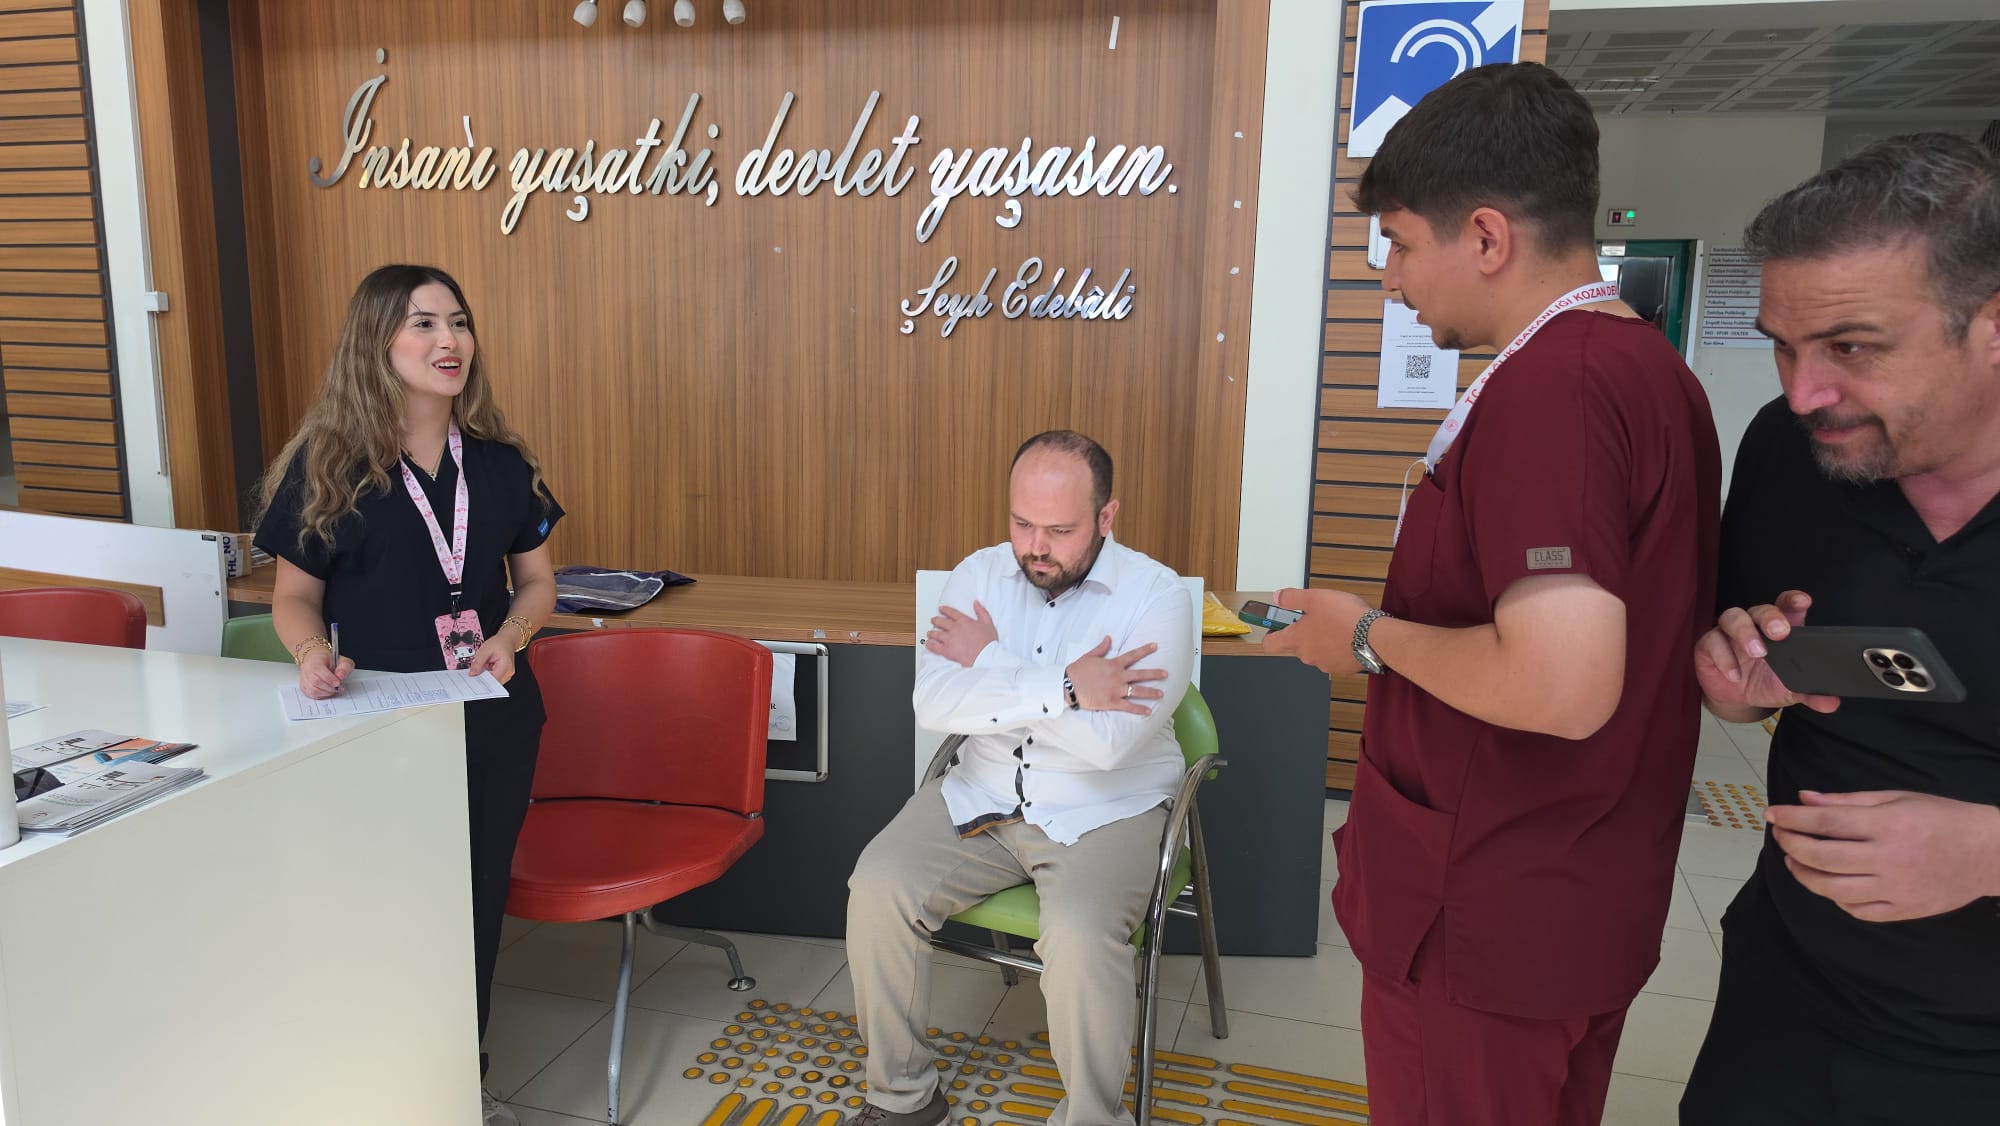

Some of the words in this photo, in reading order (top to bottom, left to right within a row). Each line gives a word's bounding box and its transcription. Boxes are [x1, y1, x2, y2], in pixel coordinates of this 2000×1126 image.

[735, 90, 920, 197] devlet
[915, 135, 1178, 243] yaşasın.
[899, 255, 997, 338] Şeyh
[1001, 256, 1136, 321] Edebâli
[1515, 299, 1573, 346] BAKANLIĞI
[1573, 286, 1607, 302] KOZAN
[1534, 550, 1564, 562] CLASS
